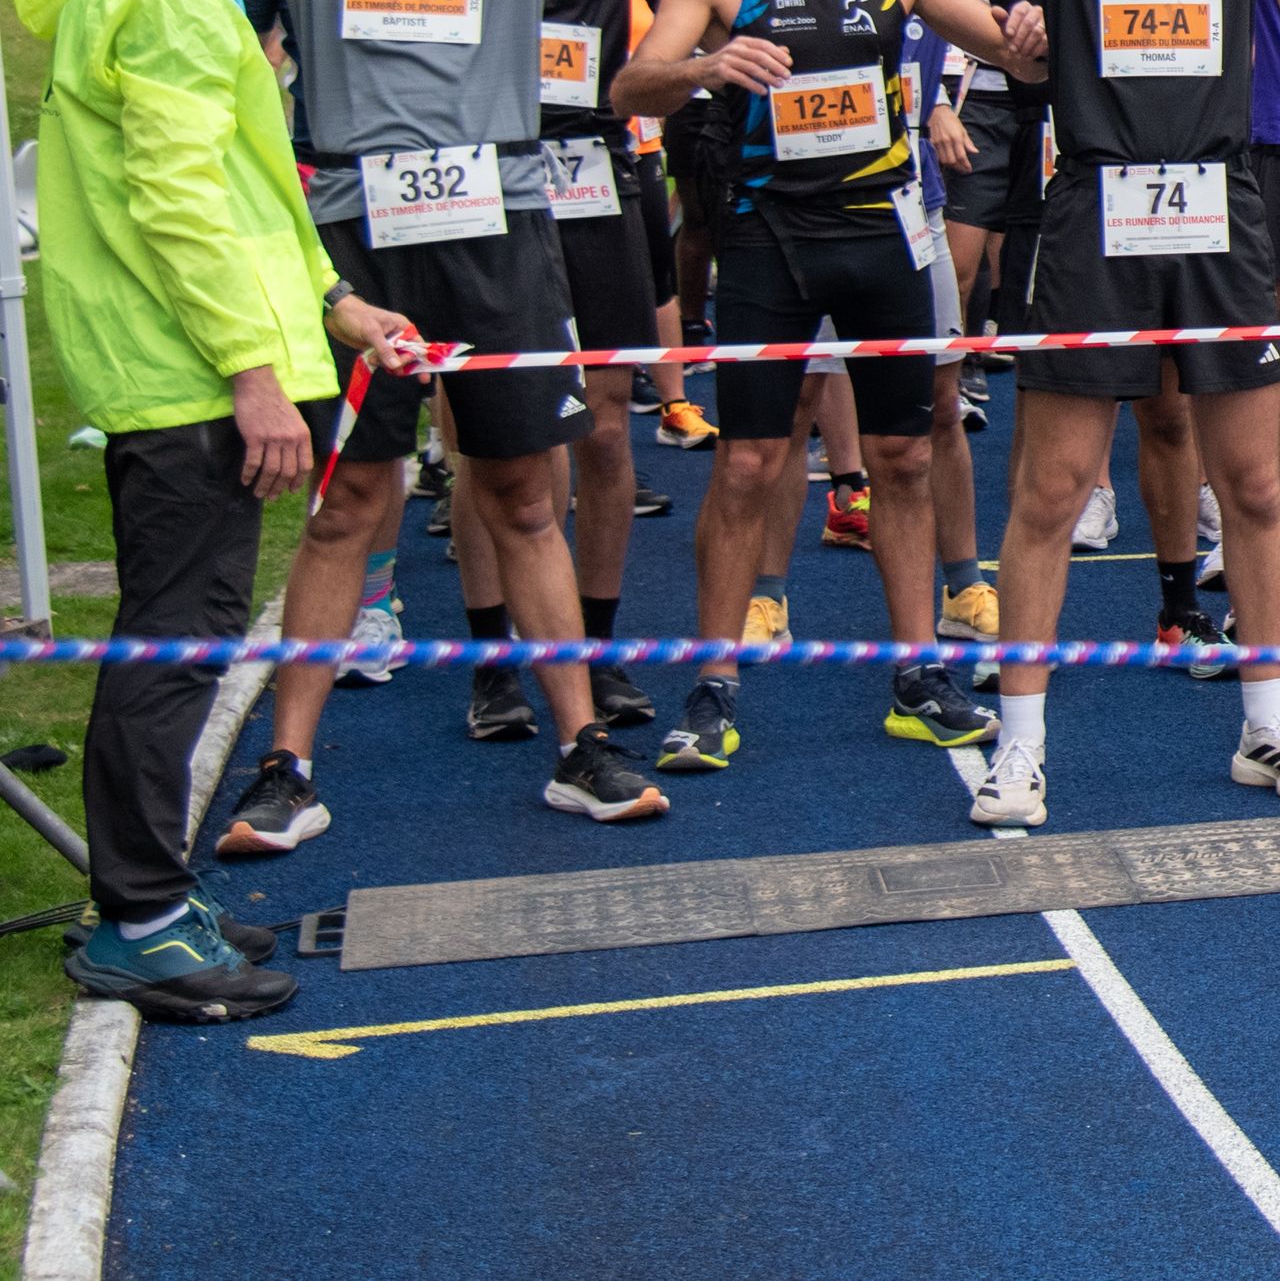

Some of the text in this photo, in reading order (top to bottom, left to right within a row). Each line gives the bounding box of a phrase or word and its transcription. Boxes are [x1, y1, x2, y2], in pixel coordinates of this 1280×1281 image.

[347, 1, 362, 9] LES
[1198, 6, 1207, 15] M
[383, 17, 427, 27] BAPTISTE
[1124, 9, 1190, 35] 74-A
[843, 25, 873, 33] ENAA
[1212, 22, 1220, 42] 74-A
[1104, 39, 1208, 47] LES RUNNERS DU DIMANCHE
[1141, 53, 1176, 62] THOMAS
[863, 83, 871, 94] M
[795, 90, 857, 120] 12-A
[777, 124, 790, 133] LES
[792, 121, 827, 130] MASTERS
[816, 133, 842, 143] TEDDY
[400, 165, 468, 202] 332
[601, 185, 610, 197] 6
[1146, 182, 1188, 214] 74
[371, 209, 388, 218] LES
[436, 203, 448, 211] DE
[1107, 215, 1226, 227] LES RUNNERS DU DIMANCHE
